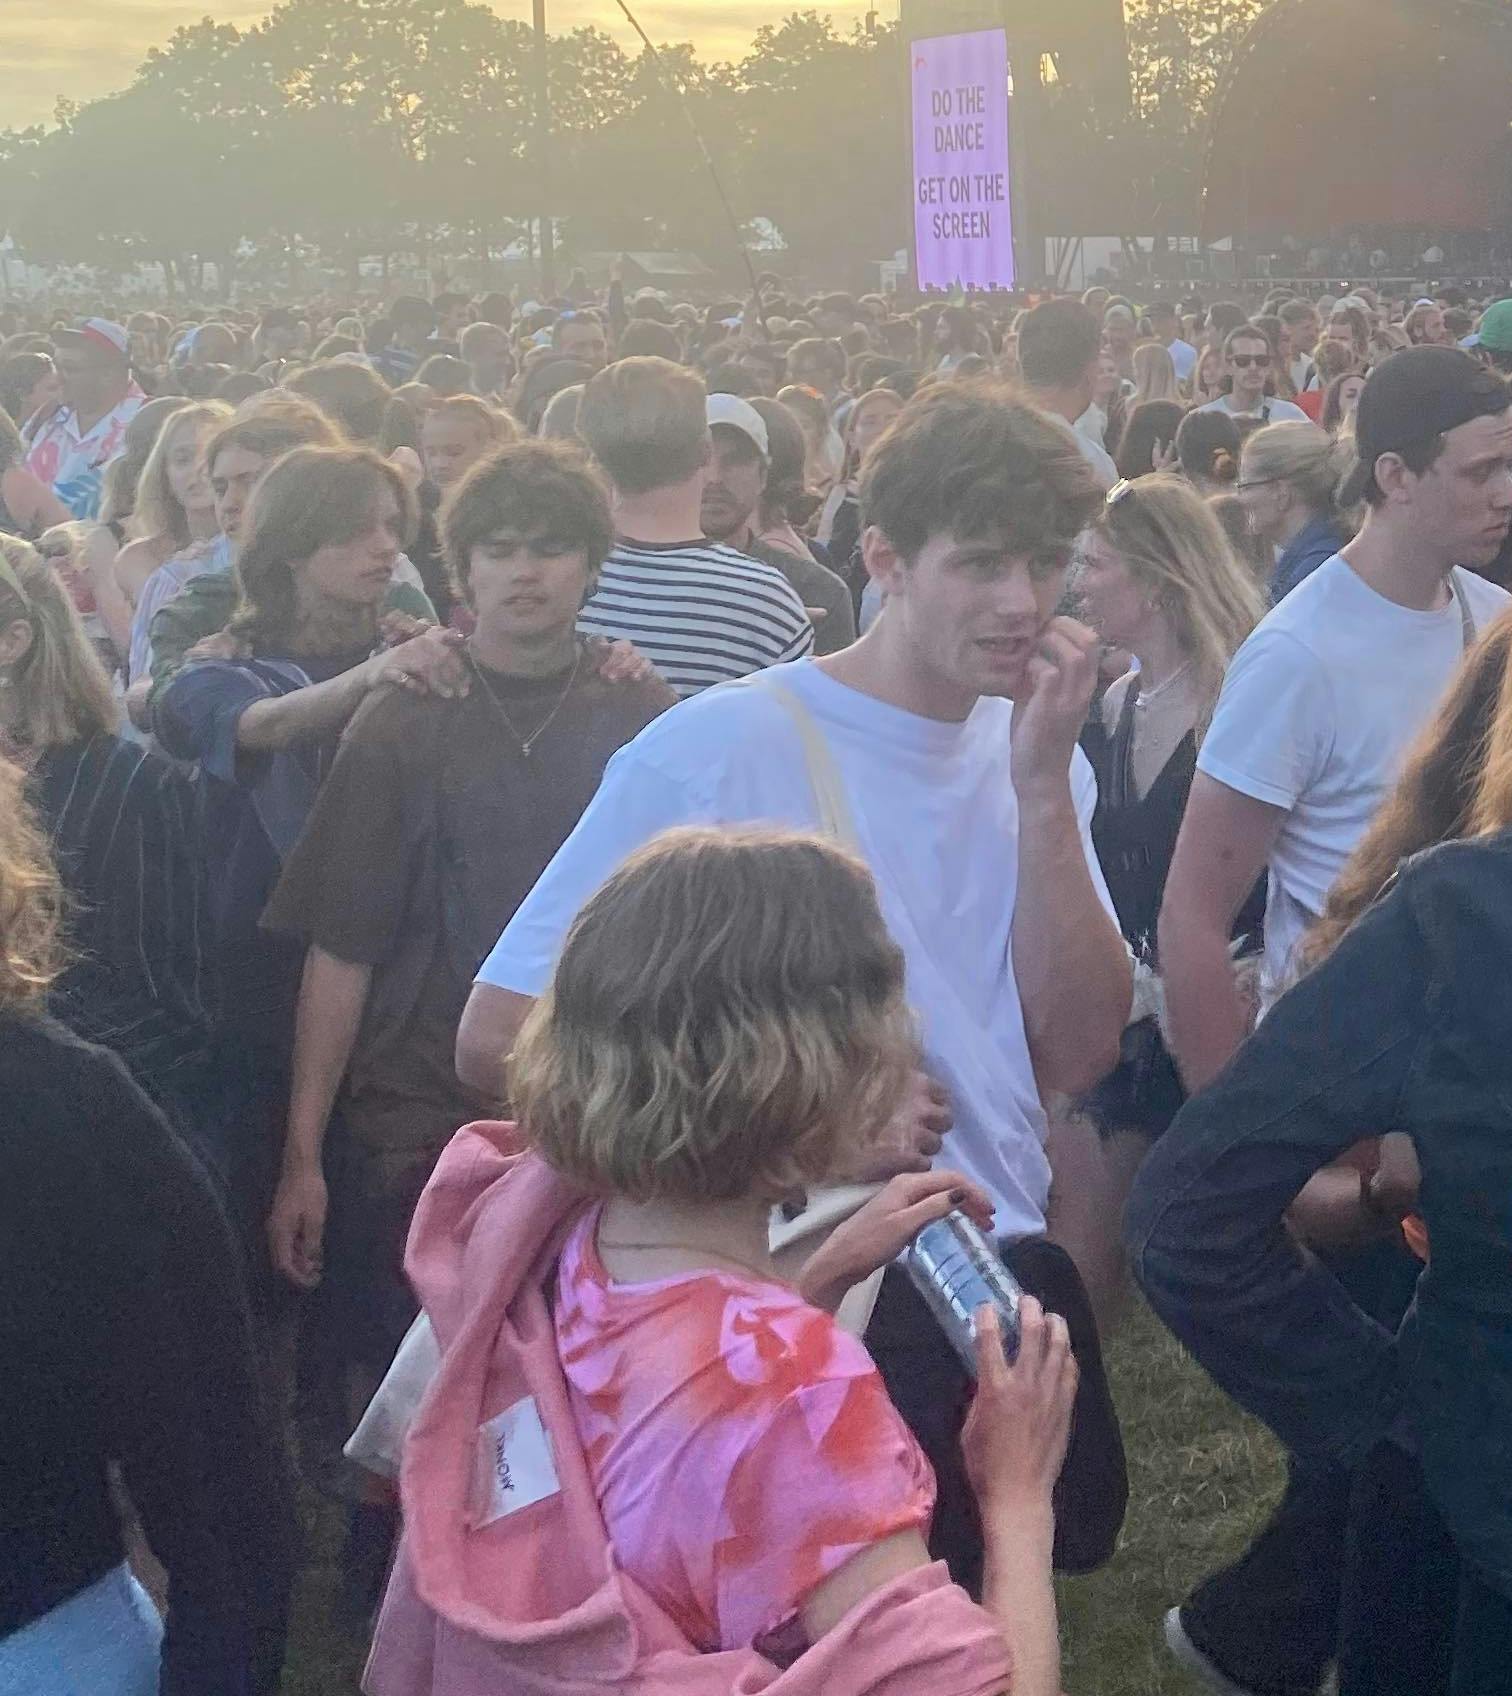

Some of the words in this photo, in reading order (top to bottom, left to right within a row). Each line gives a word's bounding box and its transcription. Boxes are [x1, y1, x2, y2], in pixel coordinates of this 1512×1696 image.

[932, 89, 952, 117] DO
[956, 86, 986, 115] THE
[934, 123, 985, 152] DANCE
[918, 177, 945, 204] GET
[950, 175, 971, 203] ON
[974, 173, 1005, 202] THE
[932, 211, 991, 240] SCREEN
